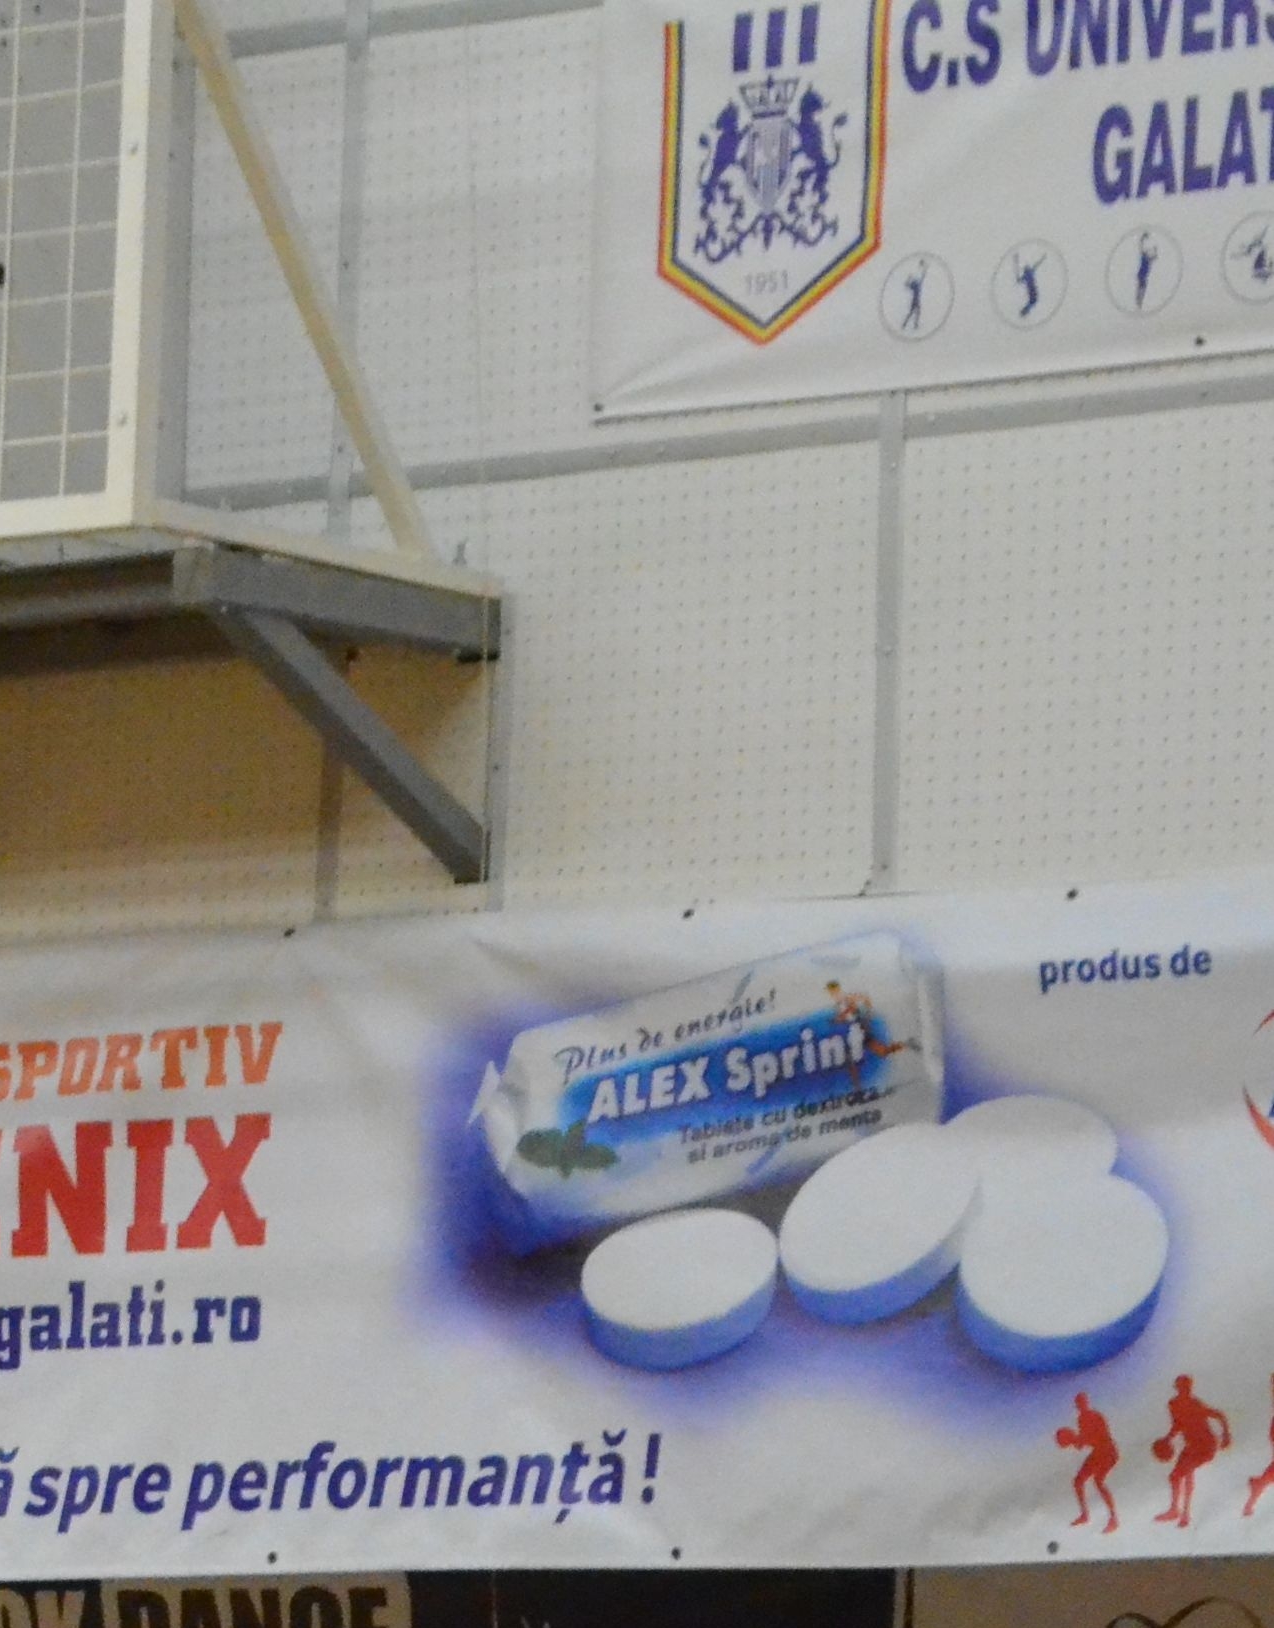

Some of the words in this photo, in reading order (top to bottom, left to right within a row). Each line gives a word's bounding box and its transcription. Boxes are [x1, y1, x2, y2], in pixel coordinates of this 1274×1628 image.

[1038, 946, 1162, 994] produs
[1170, 944, 1213, 980] de
[586, 1055, 711, 1124] ALEX
[723, 1021, 867, 1098] Sprint
[24, 1457, 172, 1533] spre
